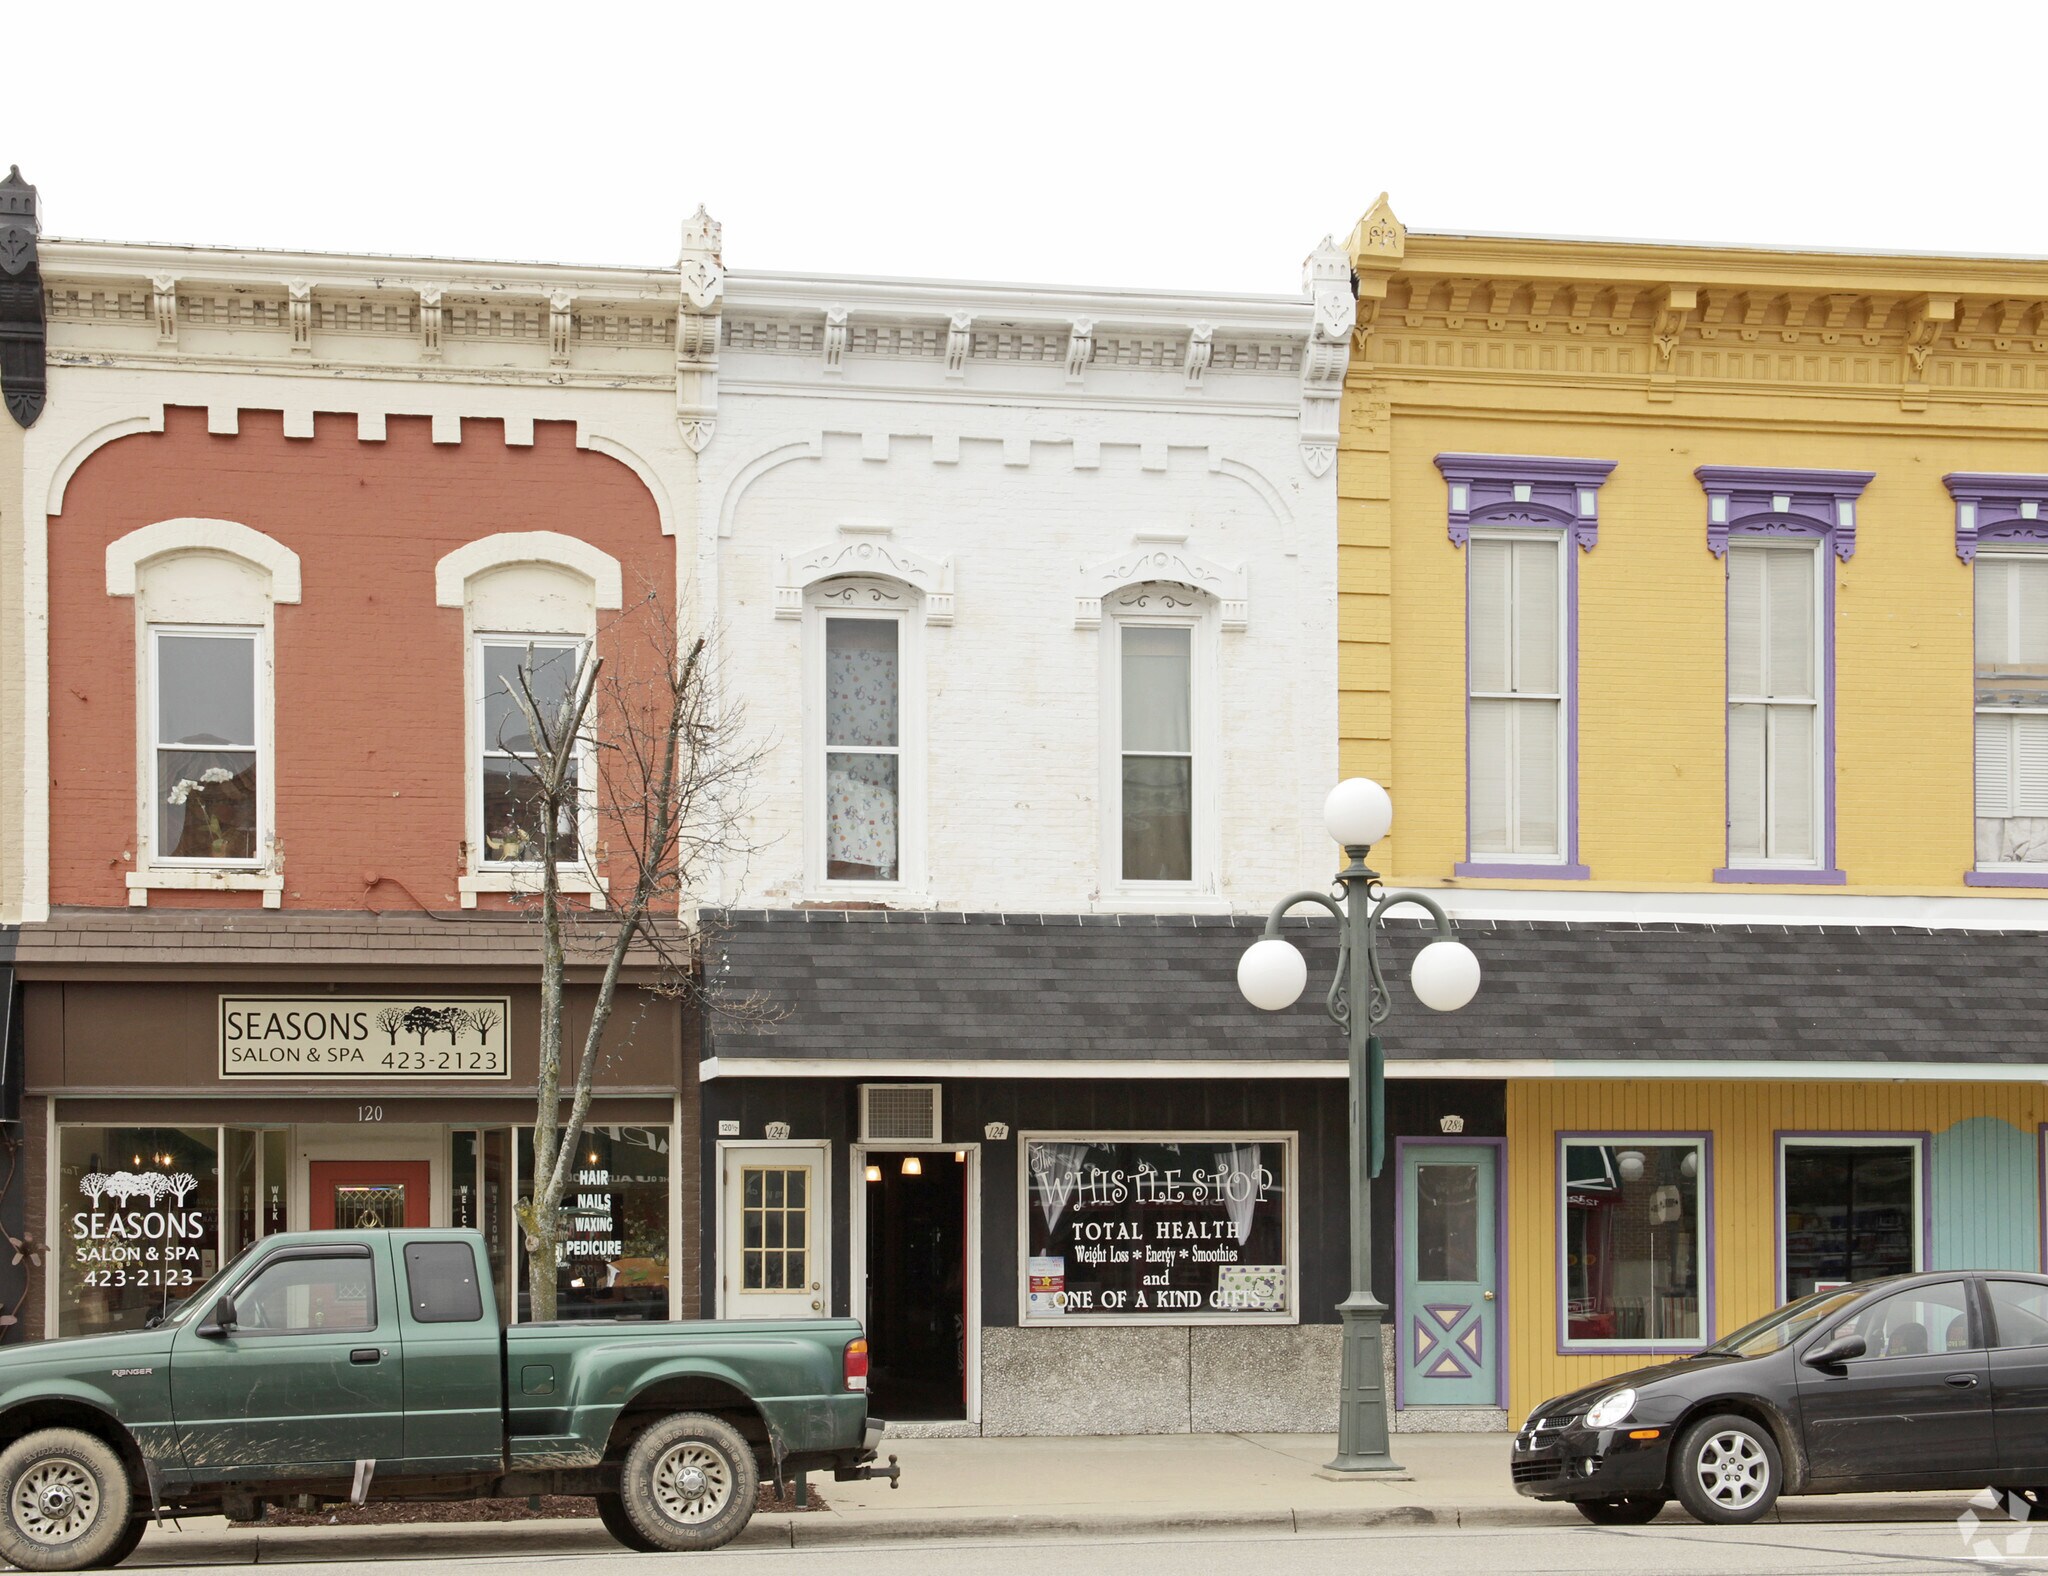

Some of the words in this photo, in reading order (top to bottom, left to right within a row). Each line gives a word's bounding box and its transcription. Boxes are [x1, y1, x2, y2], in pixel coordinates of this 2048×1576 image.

[227, 1012, 369, 1040] SEASONS
[231, 1047, 300, 1062] SALON
[306, 1047, 321, 1062] &
[327, 1047, 365, 1062] SPA
[381, 1052, 497, 1070] 423-2123
[358, 1105, 383, 1121] 120
[988, 1126, 1005, 1138] 124
[579, 1170, 609, 1185] HAIR
[1035, 1163, 1185, 1211] WHISTLE
[1192, 1163, 1273, 1203] STOP
[271, 1186, 279, 1220] WALK
[577, 1193, 611, 1209] NAILS
[73, 1212, 204, 1239] SEASONS
[575, 1217, 613, 1232] WAXING
[1072, 1222, 1143, 1240] TOTAL
[1156, 1221, 1241, 1240] HEALTH
[76, 1247, 140, 1261] SALON
[145, 1247, 159, 1260] &
[164, 1247, 200, 1260] SPA
[566, 1240, 622, 1256] PEDICURE
[1075, 1245, 1107, 1268] Weight
[1110, 1245, 1129, 1263] Loss
[1145, 1246, 1176, 1269] Energy
[1192, 1245, 1238, 1263] Smoothies
[84, 1269, 193, 1287] 423-2123
[1143, 1270, 1170, 1285] and
[1052, 1291, 1093, 1309] ONE
[1101, 1291, 1127, 1308] OF
[1135, 1291, 1149, 1308] A
[1156, 1290, 1202, 1308] KIND
[1209, 1290, 1261, 1308] GIFTS
[111, 1367, 153, 1377] RANGER
